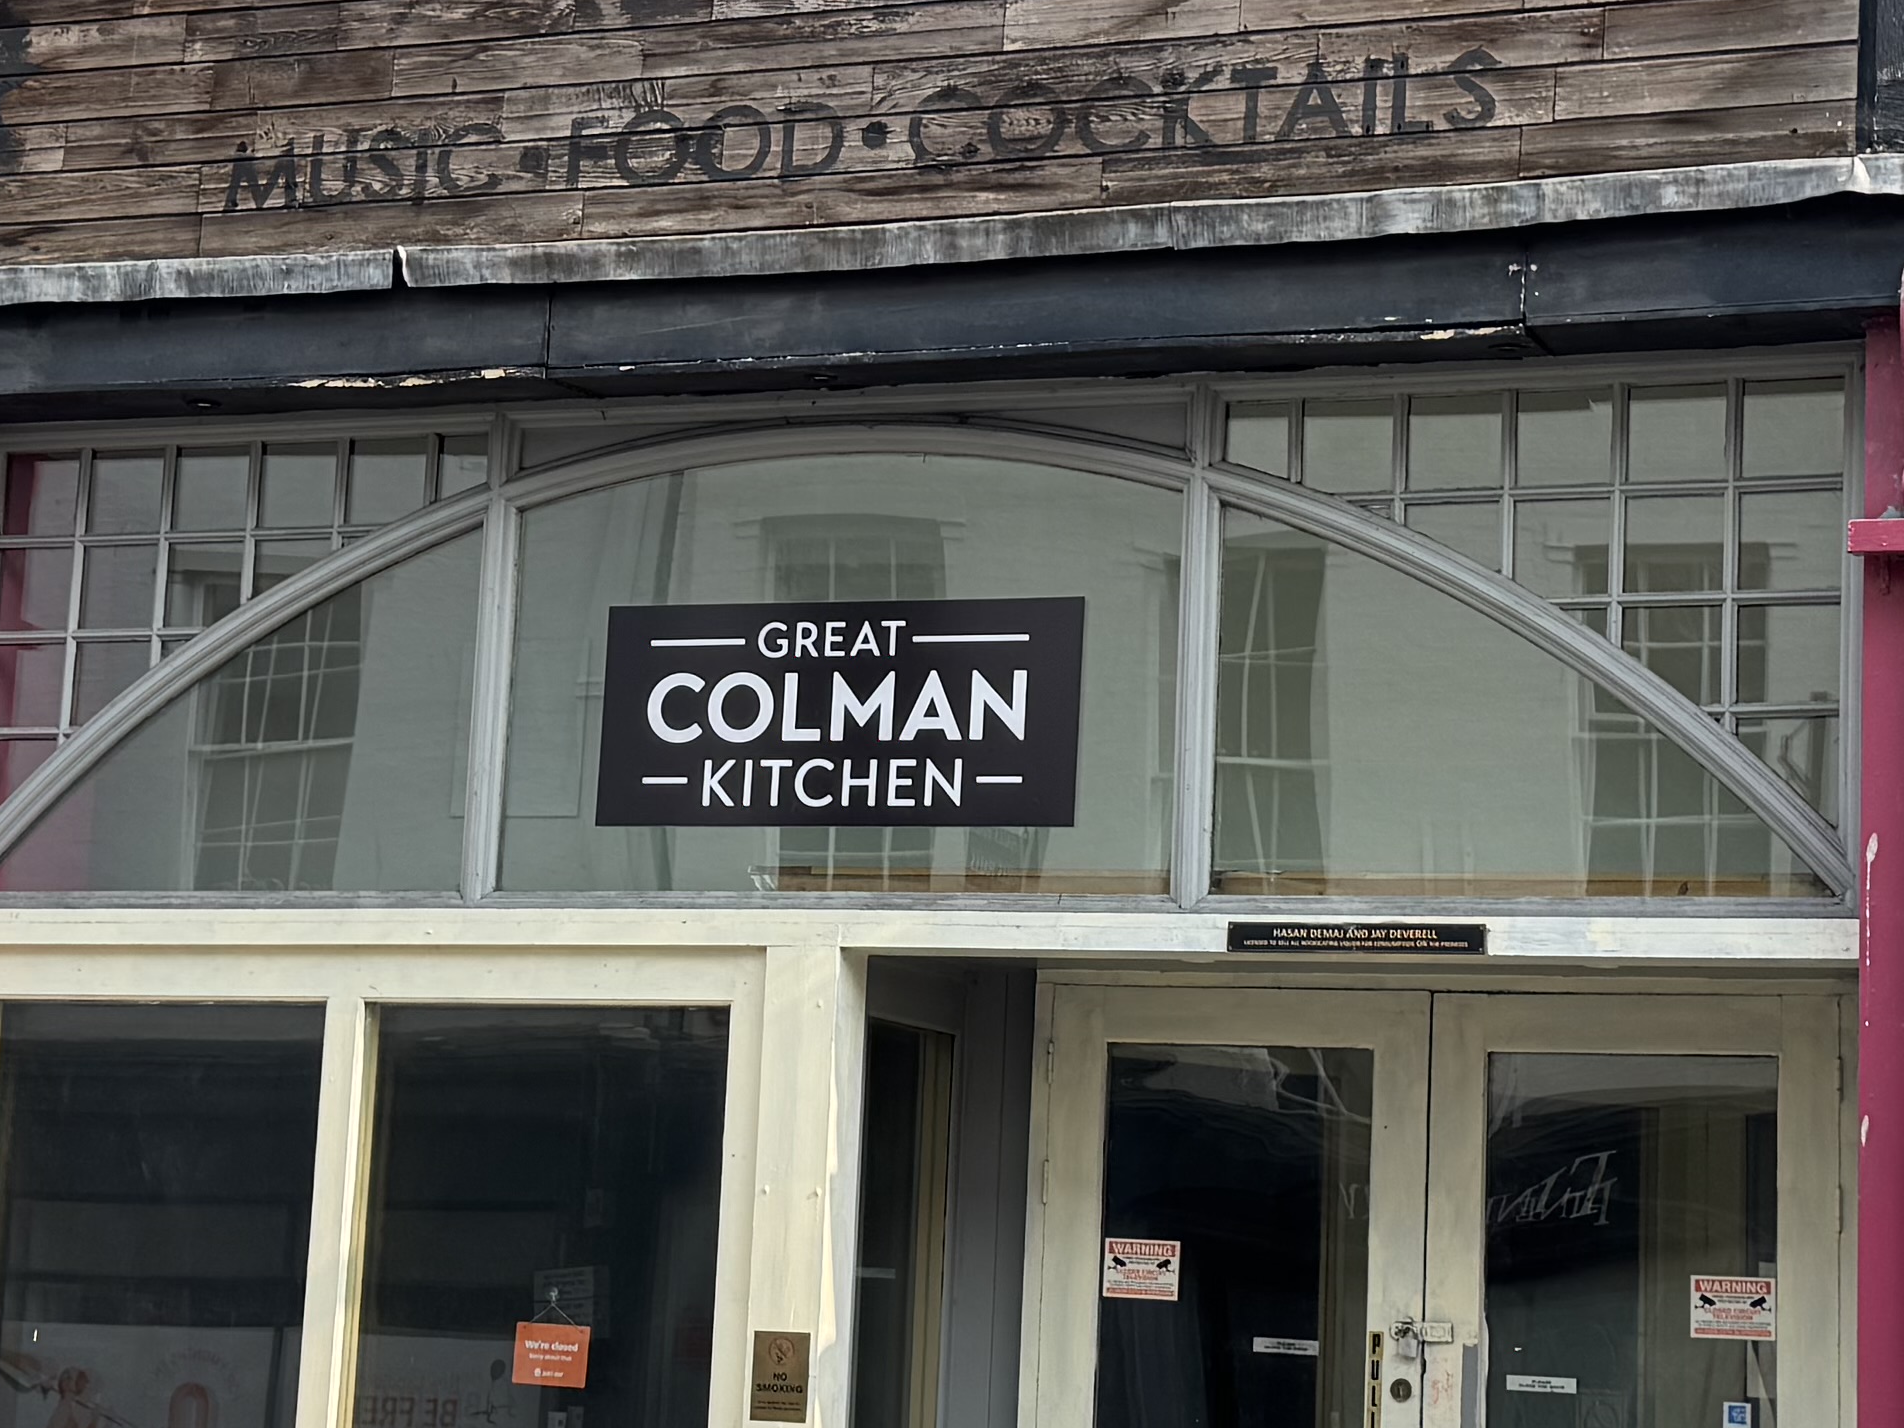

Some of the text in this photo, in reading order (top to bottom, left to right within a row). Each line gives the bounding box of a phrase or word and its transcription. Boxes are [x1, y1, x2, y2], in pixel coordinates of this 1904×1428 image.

[223, 46, 1501, 211] MUSIC FOOD COCKTAILS
[757, 620, 906, 658] GREAT
[647, 670, 1028, 743] COLMAN
[701, 758, 962, 808] KITCHEN
[1273, 928, 1307, 938] HASAN
[1346, 928, 1368, 939] AND
[1112, 1243, 1173, 1256] WARNING
[1699, 1280, 1767, 1293] WARNING
[525, 1340, 578, 1352] We're closed
[773, 1372, 787, 1381] NO
[756, 1383, 803, 1393] SMOKING
